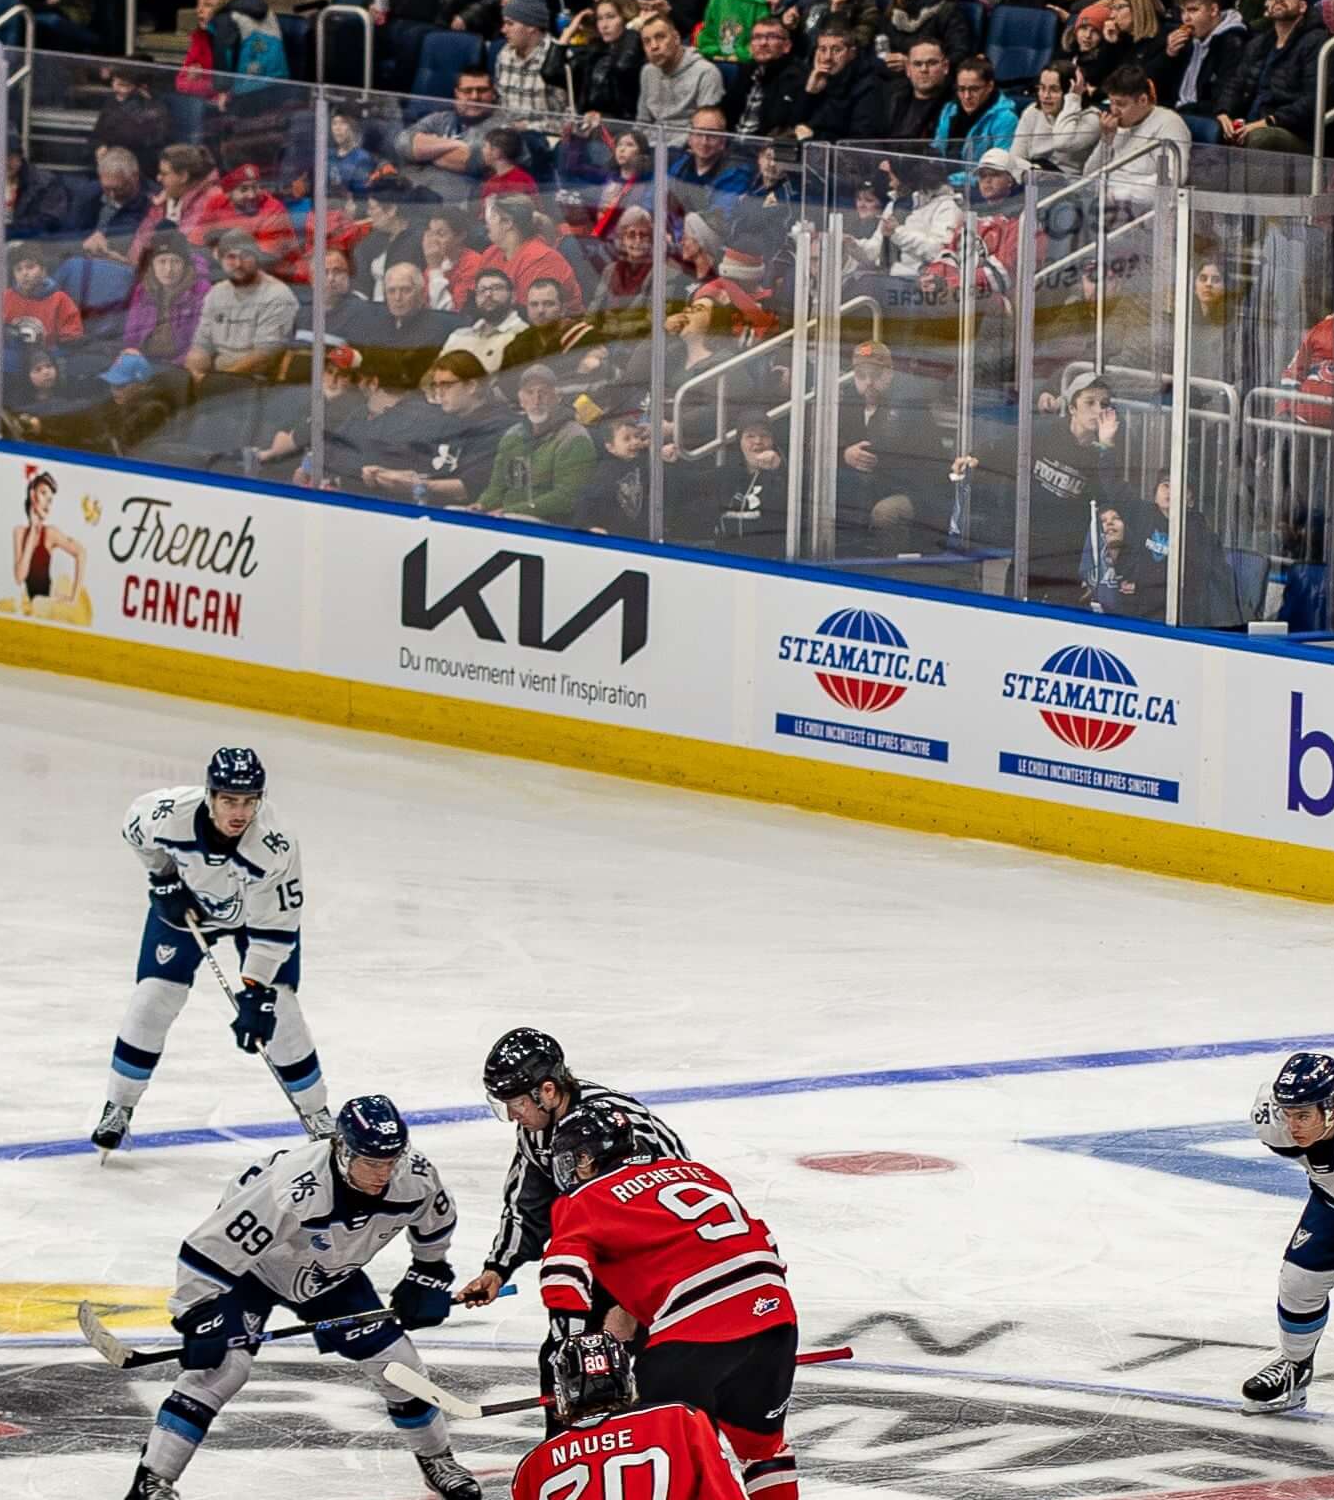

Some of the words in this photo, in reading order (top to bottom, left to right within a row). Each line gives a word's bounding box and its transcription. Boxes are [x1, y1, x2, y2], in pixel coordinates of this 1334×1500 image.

[108, 496, 258, 579] French
[122, 574, 243, 638] CANCAN
[401, 537, 650, 666] KIA
[400, 647, 422, 672] Du
[424, 655, 516, 689] mouvement
[518, 668, 557, 696] vient
[778, 635, 948, 688] STEAMATIC.CA
[1002, 672, 1178, 727] STEAMATIC.CA
[794, 719, 805, 735] LE
[804, 721, 825, 739] CHOIX
[825, 724, 867, 743] INCONTESTÉ
[867, 730, 877, 746] EN
[877, 732, 899, 750] APRÈS
[899, 736, 931, 757] SINISTRE
[234, 760, 248, 771] 15
[1018, 758, 1029, 774] LE
[1028, 760, 1050, 778] CHOIX
[1049, 763, 1092, 785] INCONTESTÉ
[1093, 771, 1104, 787] EN
[1104, 773, 1128, 791] APRÈS
[1128, 777, 1161, 797] SINISTRE
[275, 879, 304, 912] 15
[379, 1120, 399, 1135] 89
[611, 1164, 712, 1204] ROCHETTE
[225, 1209, 273, 1257] 89
[656, 1181, 750, 1242] 9
[404, 1270, 452, 1291] CCM
[552, 1428, 634, 1467] NAUSE
